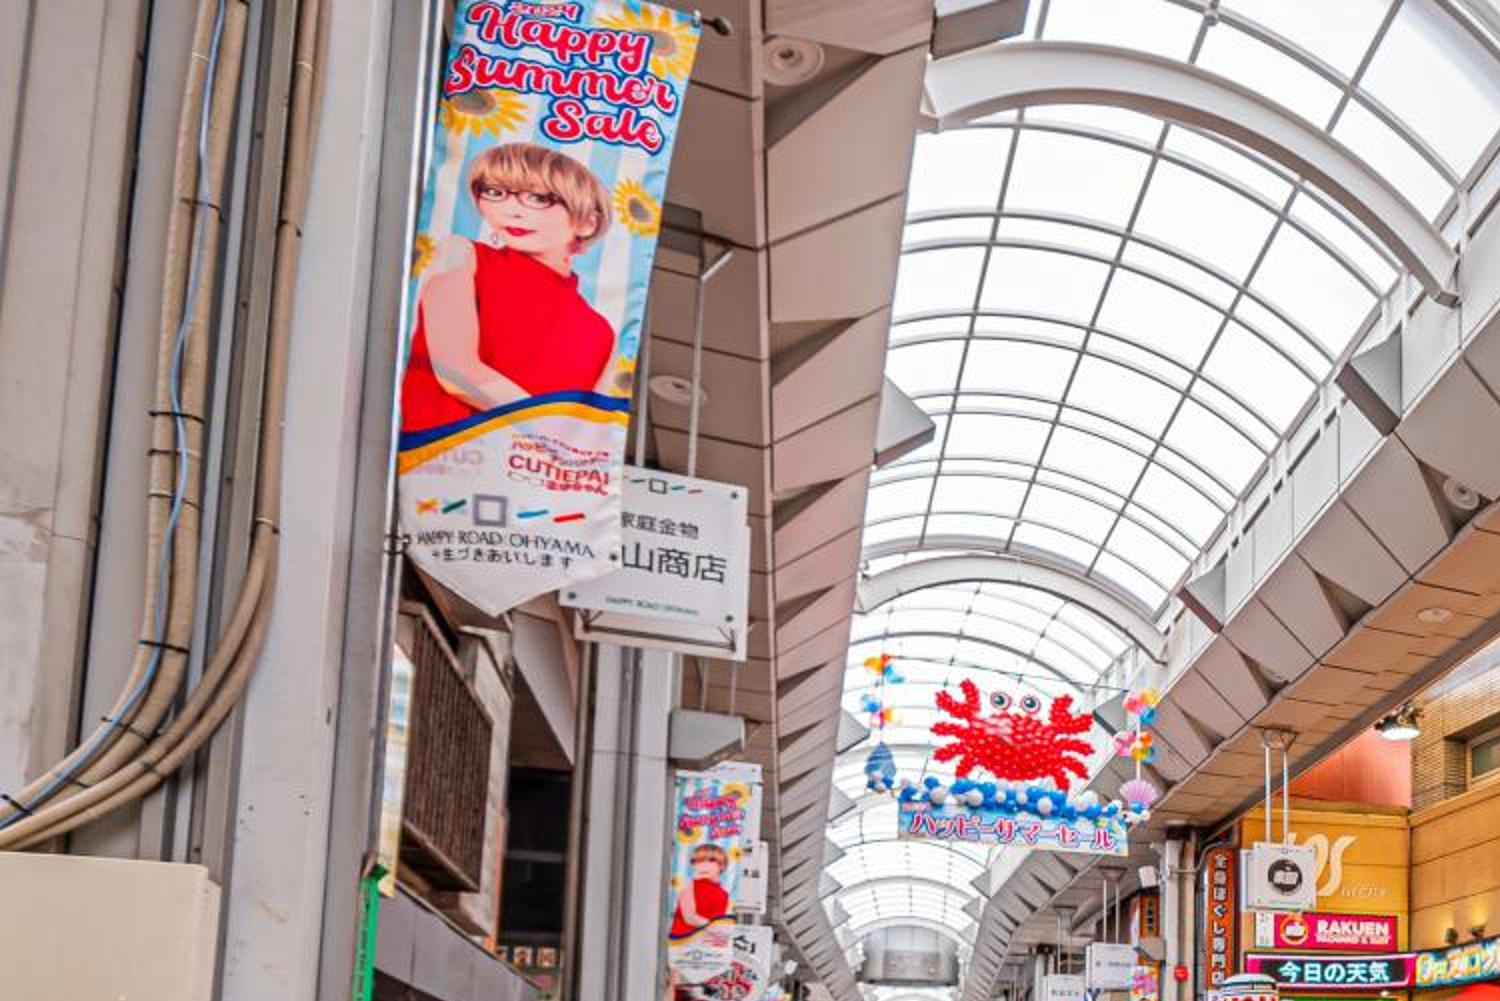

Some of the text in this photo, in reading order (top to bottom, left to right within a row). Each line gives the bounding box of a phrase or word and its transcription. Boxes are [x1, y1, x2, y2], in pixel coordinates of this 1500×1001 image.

[468, 3, 650, 73] Happy
[444, 46, 676, 112] Summer
[545, 98, 664, 153] Sale
[458, 531, 502, 545] ROAD
[509, 533, 595, 559] OHYAMA
[621, 541, 728, 584] 山商店
[1317, 919, 1390, 937] RAKUEN
[1278, 961, 1390, 984] 今日の天気
